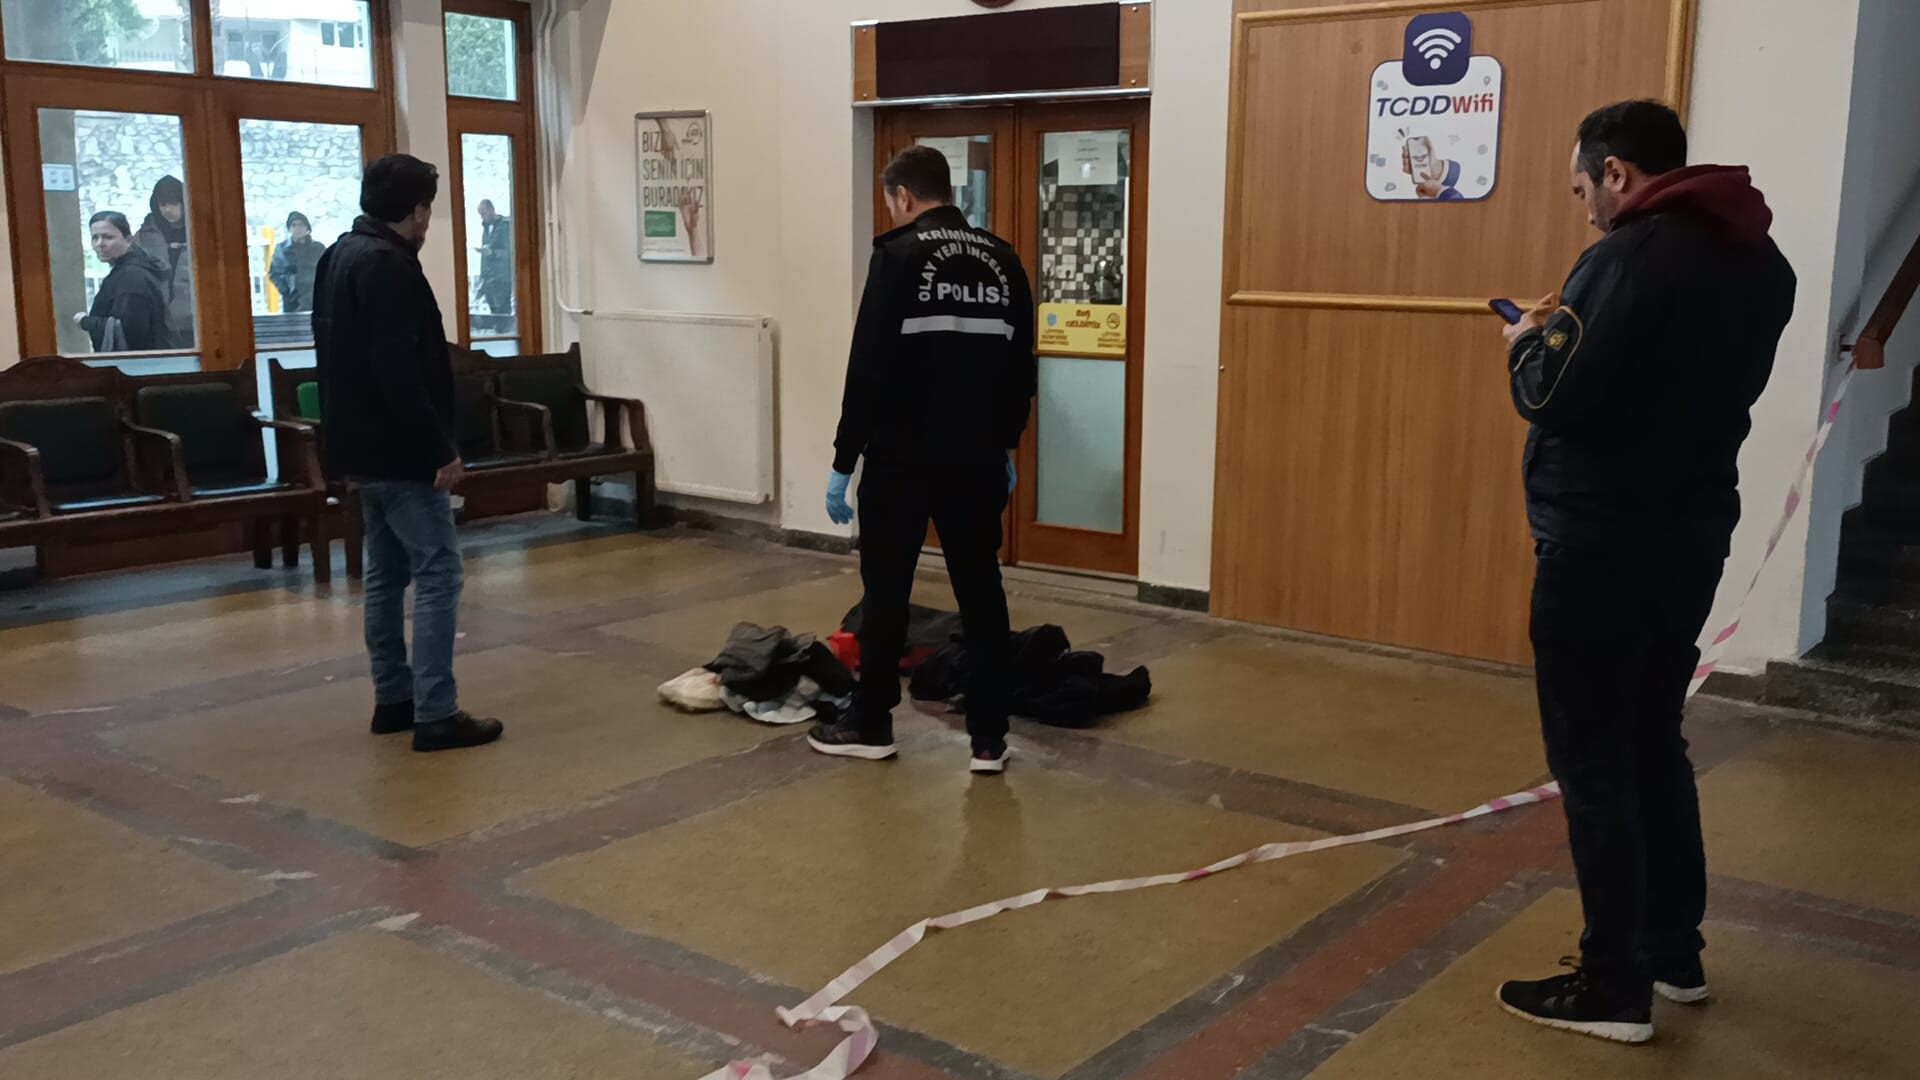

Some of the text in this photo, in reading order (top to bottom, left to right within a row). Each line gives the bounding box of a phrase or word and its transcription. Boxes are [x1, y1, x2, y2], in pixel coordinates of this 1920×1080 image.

[1376, 93, 1494, 117] TCDDWifi
[643, 185, 704, 208] BURADAYIZ
[918, 261, 937, 302] OLAY
[937, 281, 1001, 304] POLİS
